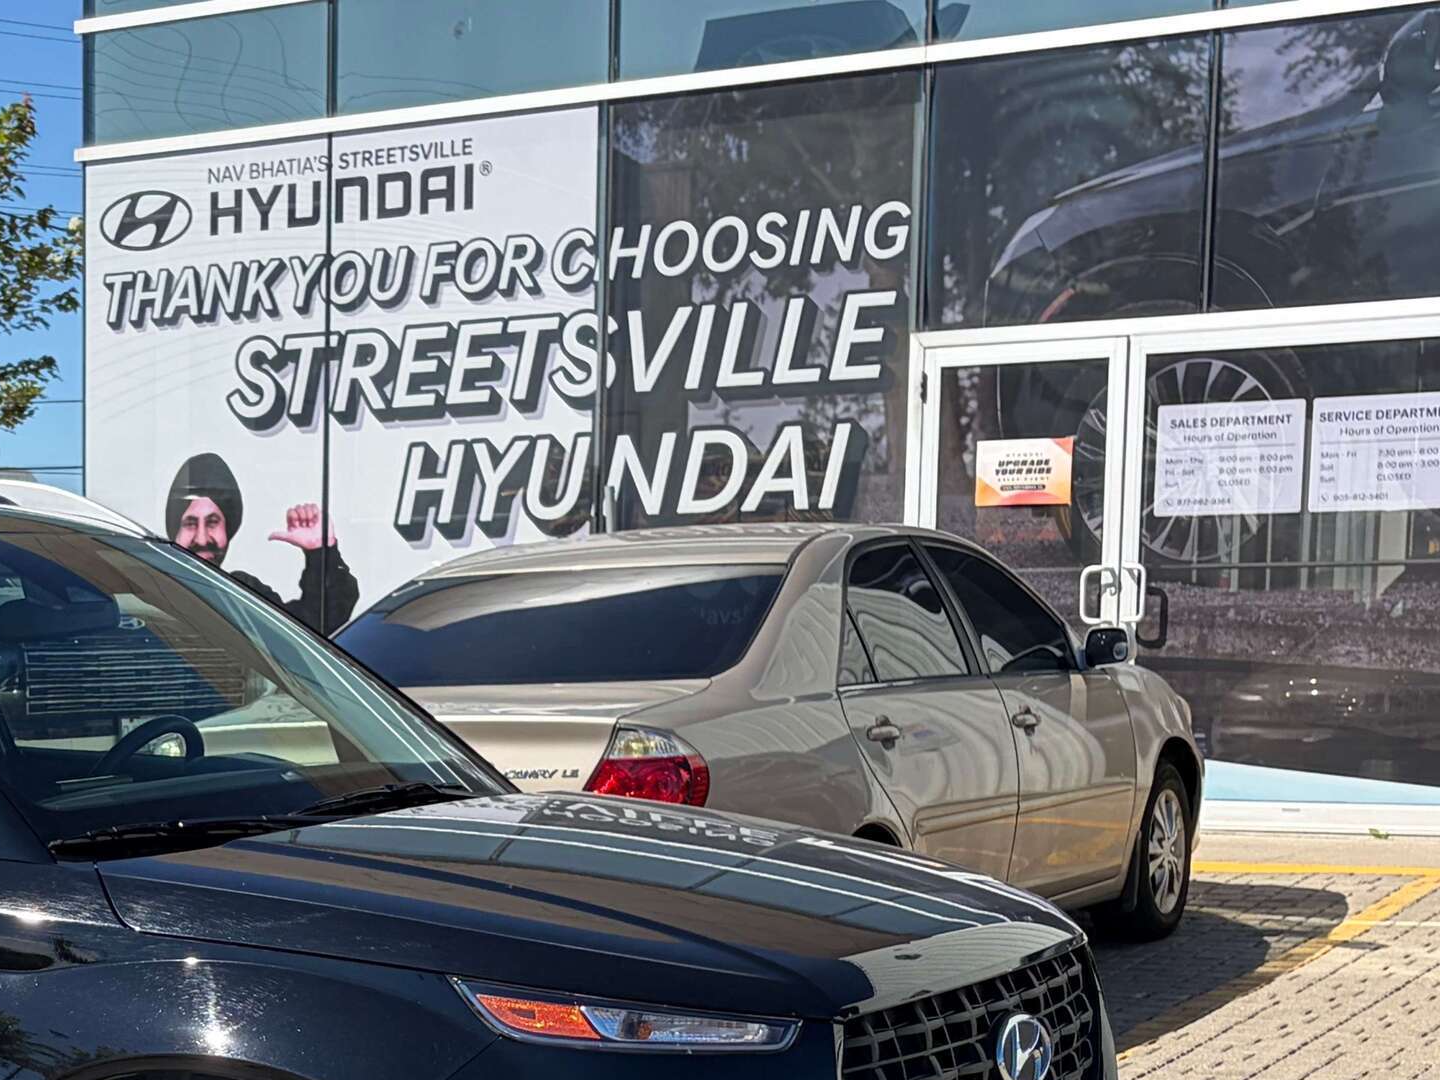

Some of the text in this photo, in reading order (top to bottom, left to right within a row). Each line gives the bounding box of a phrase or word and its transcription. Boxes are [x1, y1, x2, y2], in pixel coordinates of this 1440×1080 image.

[208, 138, 473, 184] NAV BHATIA'S STREETSVILLE
[210, 163, 474, 235] HYUNDAI
[103, 201, 912, 329] THANK YOU FOR CHOOSING
[226, 290, 899, 428] STREETSVILLE
[1170, 414, 1292, 429] SALES DEPARTMENT
[1319, 410, 1372, 423] SERVICE
[1340, 423, 1440, 437] Hours of Operation
[1183, 431, 1277, 443] Hours of Operation
[998, 458, 1051, 468] UPGRADE
[995, 466, 1052, 477] YOUR RIDE
[1376, 473, 1411, 482] CLOSED
[394, 419, 860, 540] HYUNDAI
[1217, 478, 1250, 488] CLOSED
[561, 768, 579, 778] LE
